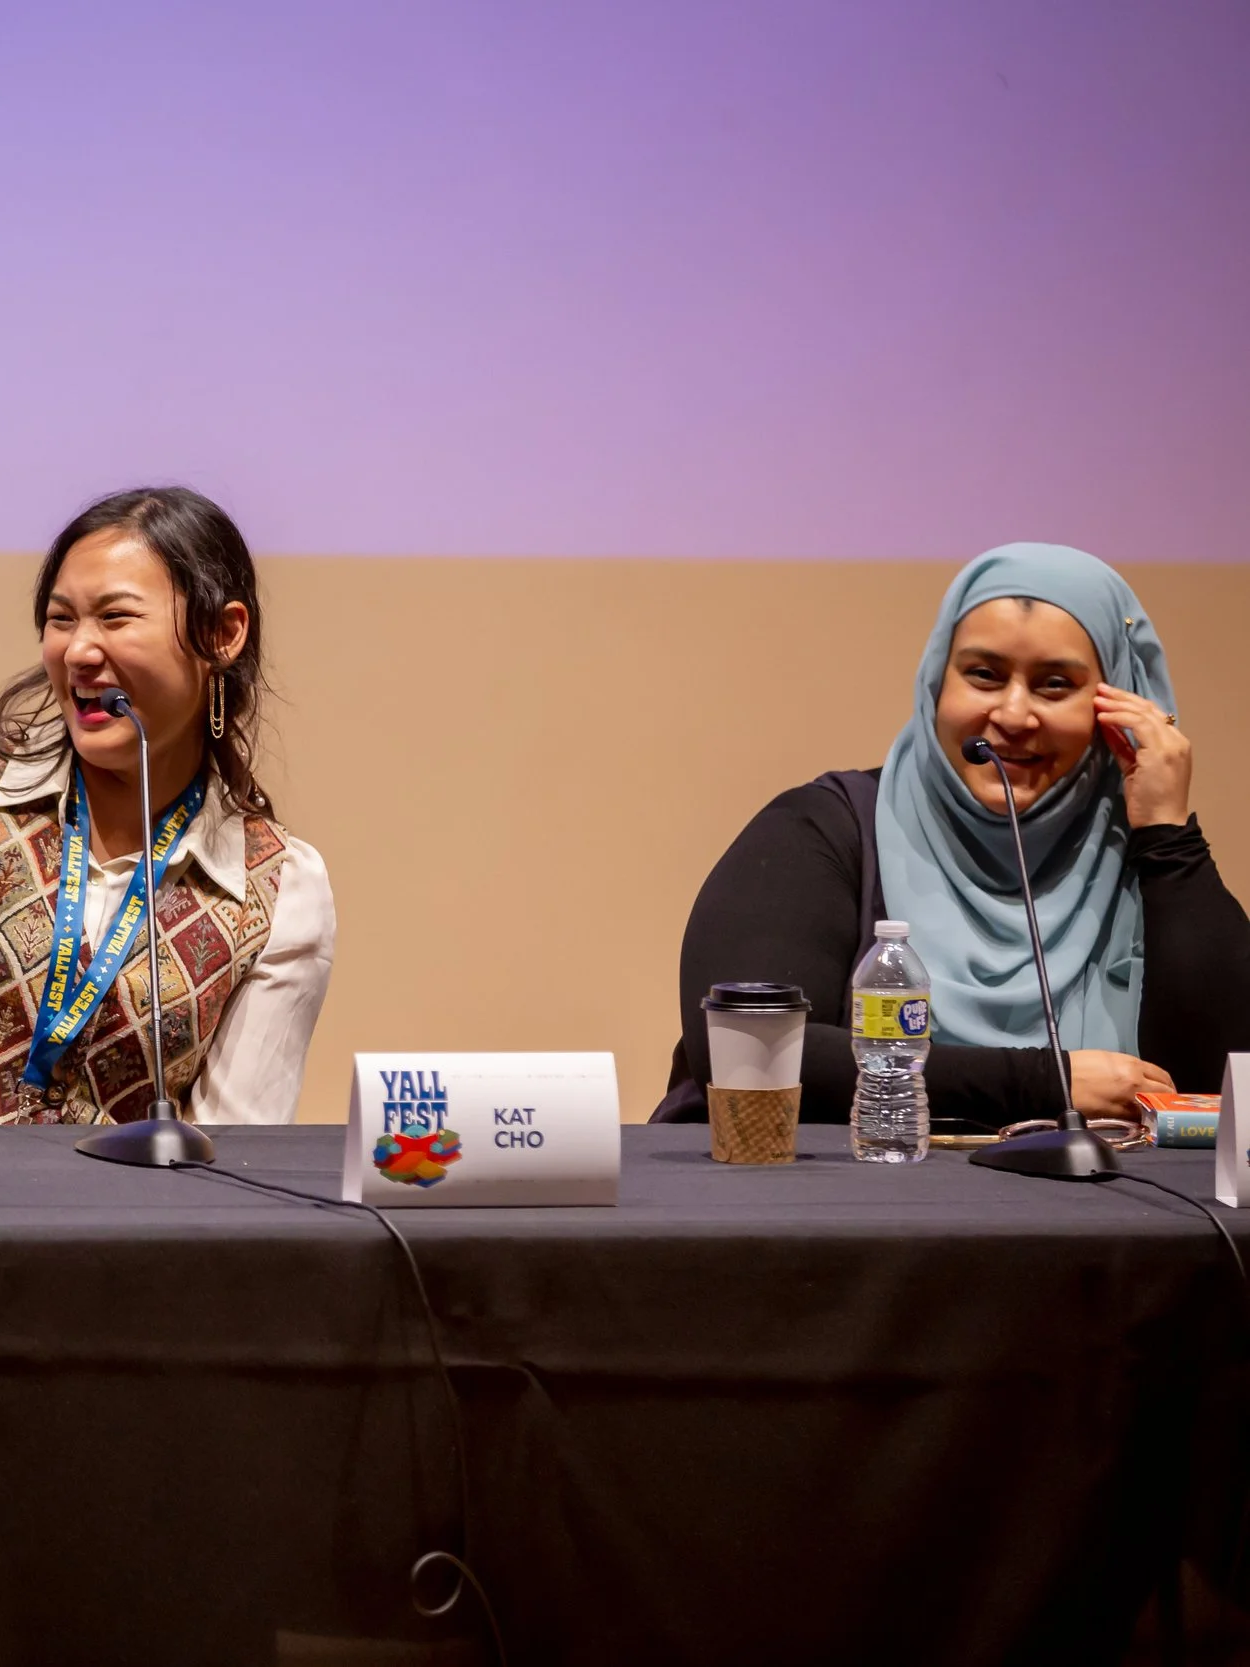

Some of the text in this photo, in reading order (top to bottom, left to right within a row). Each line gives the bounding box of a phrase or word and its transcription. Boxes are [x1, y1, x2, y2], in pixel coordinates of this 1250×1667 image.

[152, 804, 189, 861] YALLFEST
[64, 836, 83, 902] YALLFEST
[105, 896, 144, 956] YALLFEST
[47, 937, 73, 1011] YALLFEST
[47, 981, 99, 1045] YALLFEST
[379, 1070, 447, 1100] YALL
[382, 1101, 448, 1133] FEST
[493, 1108, 536, 1126] KAT
[1180, 1126, 1215, 1137] LOVE
[494, 1131, 545, 1149] CHO
